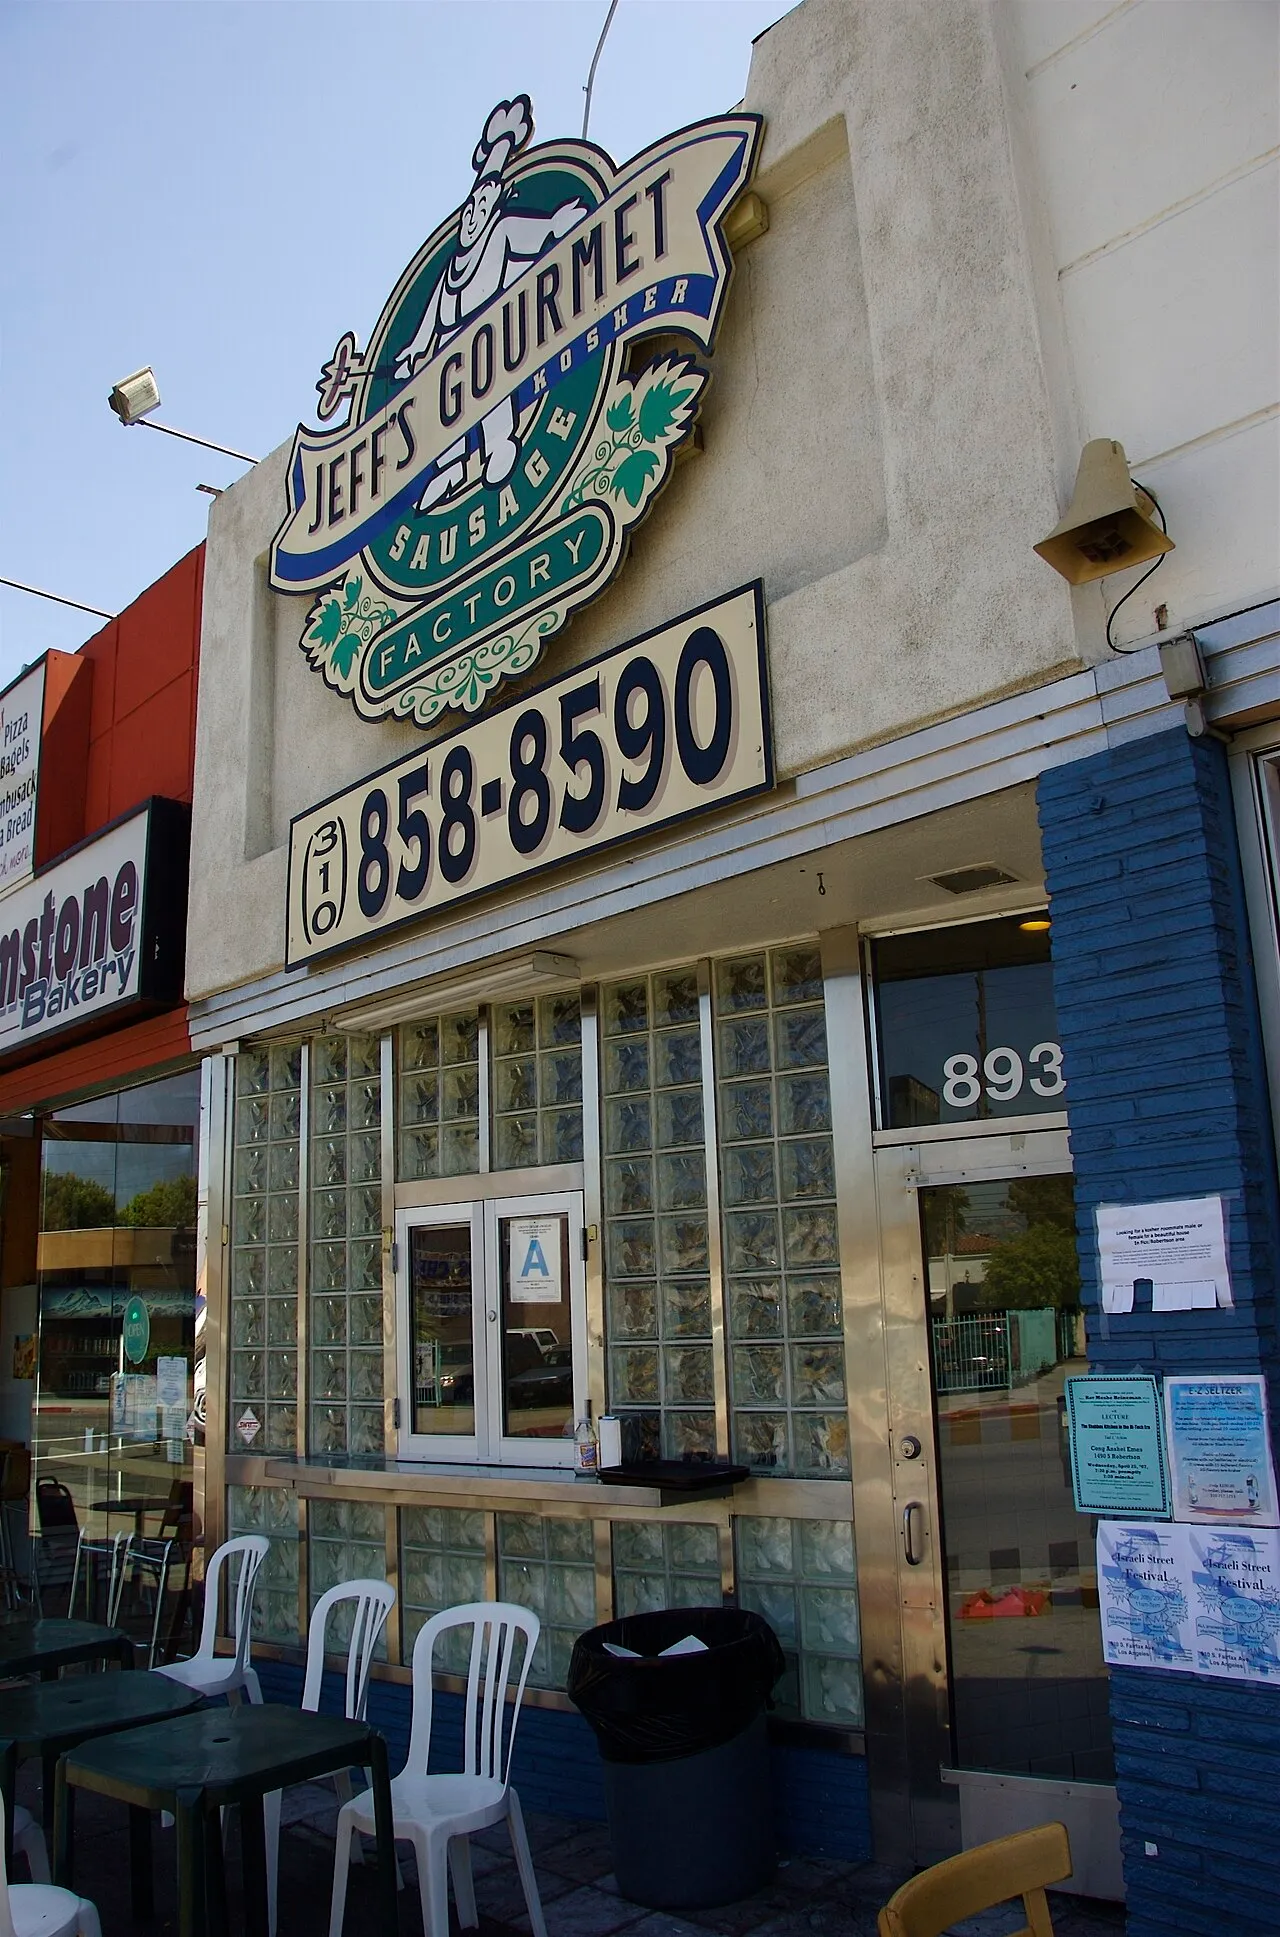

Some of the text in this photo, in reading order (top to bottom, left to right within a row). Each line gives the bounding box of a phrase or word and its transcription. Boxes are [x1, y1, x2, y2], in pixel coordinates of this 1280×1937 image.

[308, 168, 676, 536] JEFF'S GOURMET
[532, 278, 688, 396] KOSHER
[389, 404, 577, 571] SAUSAGE
[379, 529, 588, 678] FACTORY
[4, 712, 28, 748] Pizza
[0, 737, 30, 780] Bagels
[357, 625, 738, 920] 858-8590
[6, 801, 33, 843] Bread
[21, 950, 136, 1030] Bakery
[943, 1042, 1067, 1107] 893
[520, 1239, 550, 1277] A
[1204, 1386, 1242, 1395] SELTZER
[1116, 1553, 1175, 1565] Israeli Street
[1125, 1568, 1168, 1582] Festival
[1207, 1558, 1271, 1573] Israeli Street
[1218, 1575, 1265, 1591] Festival
